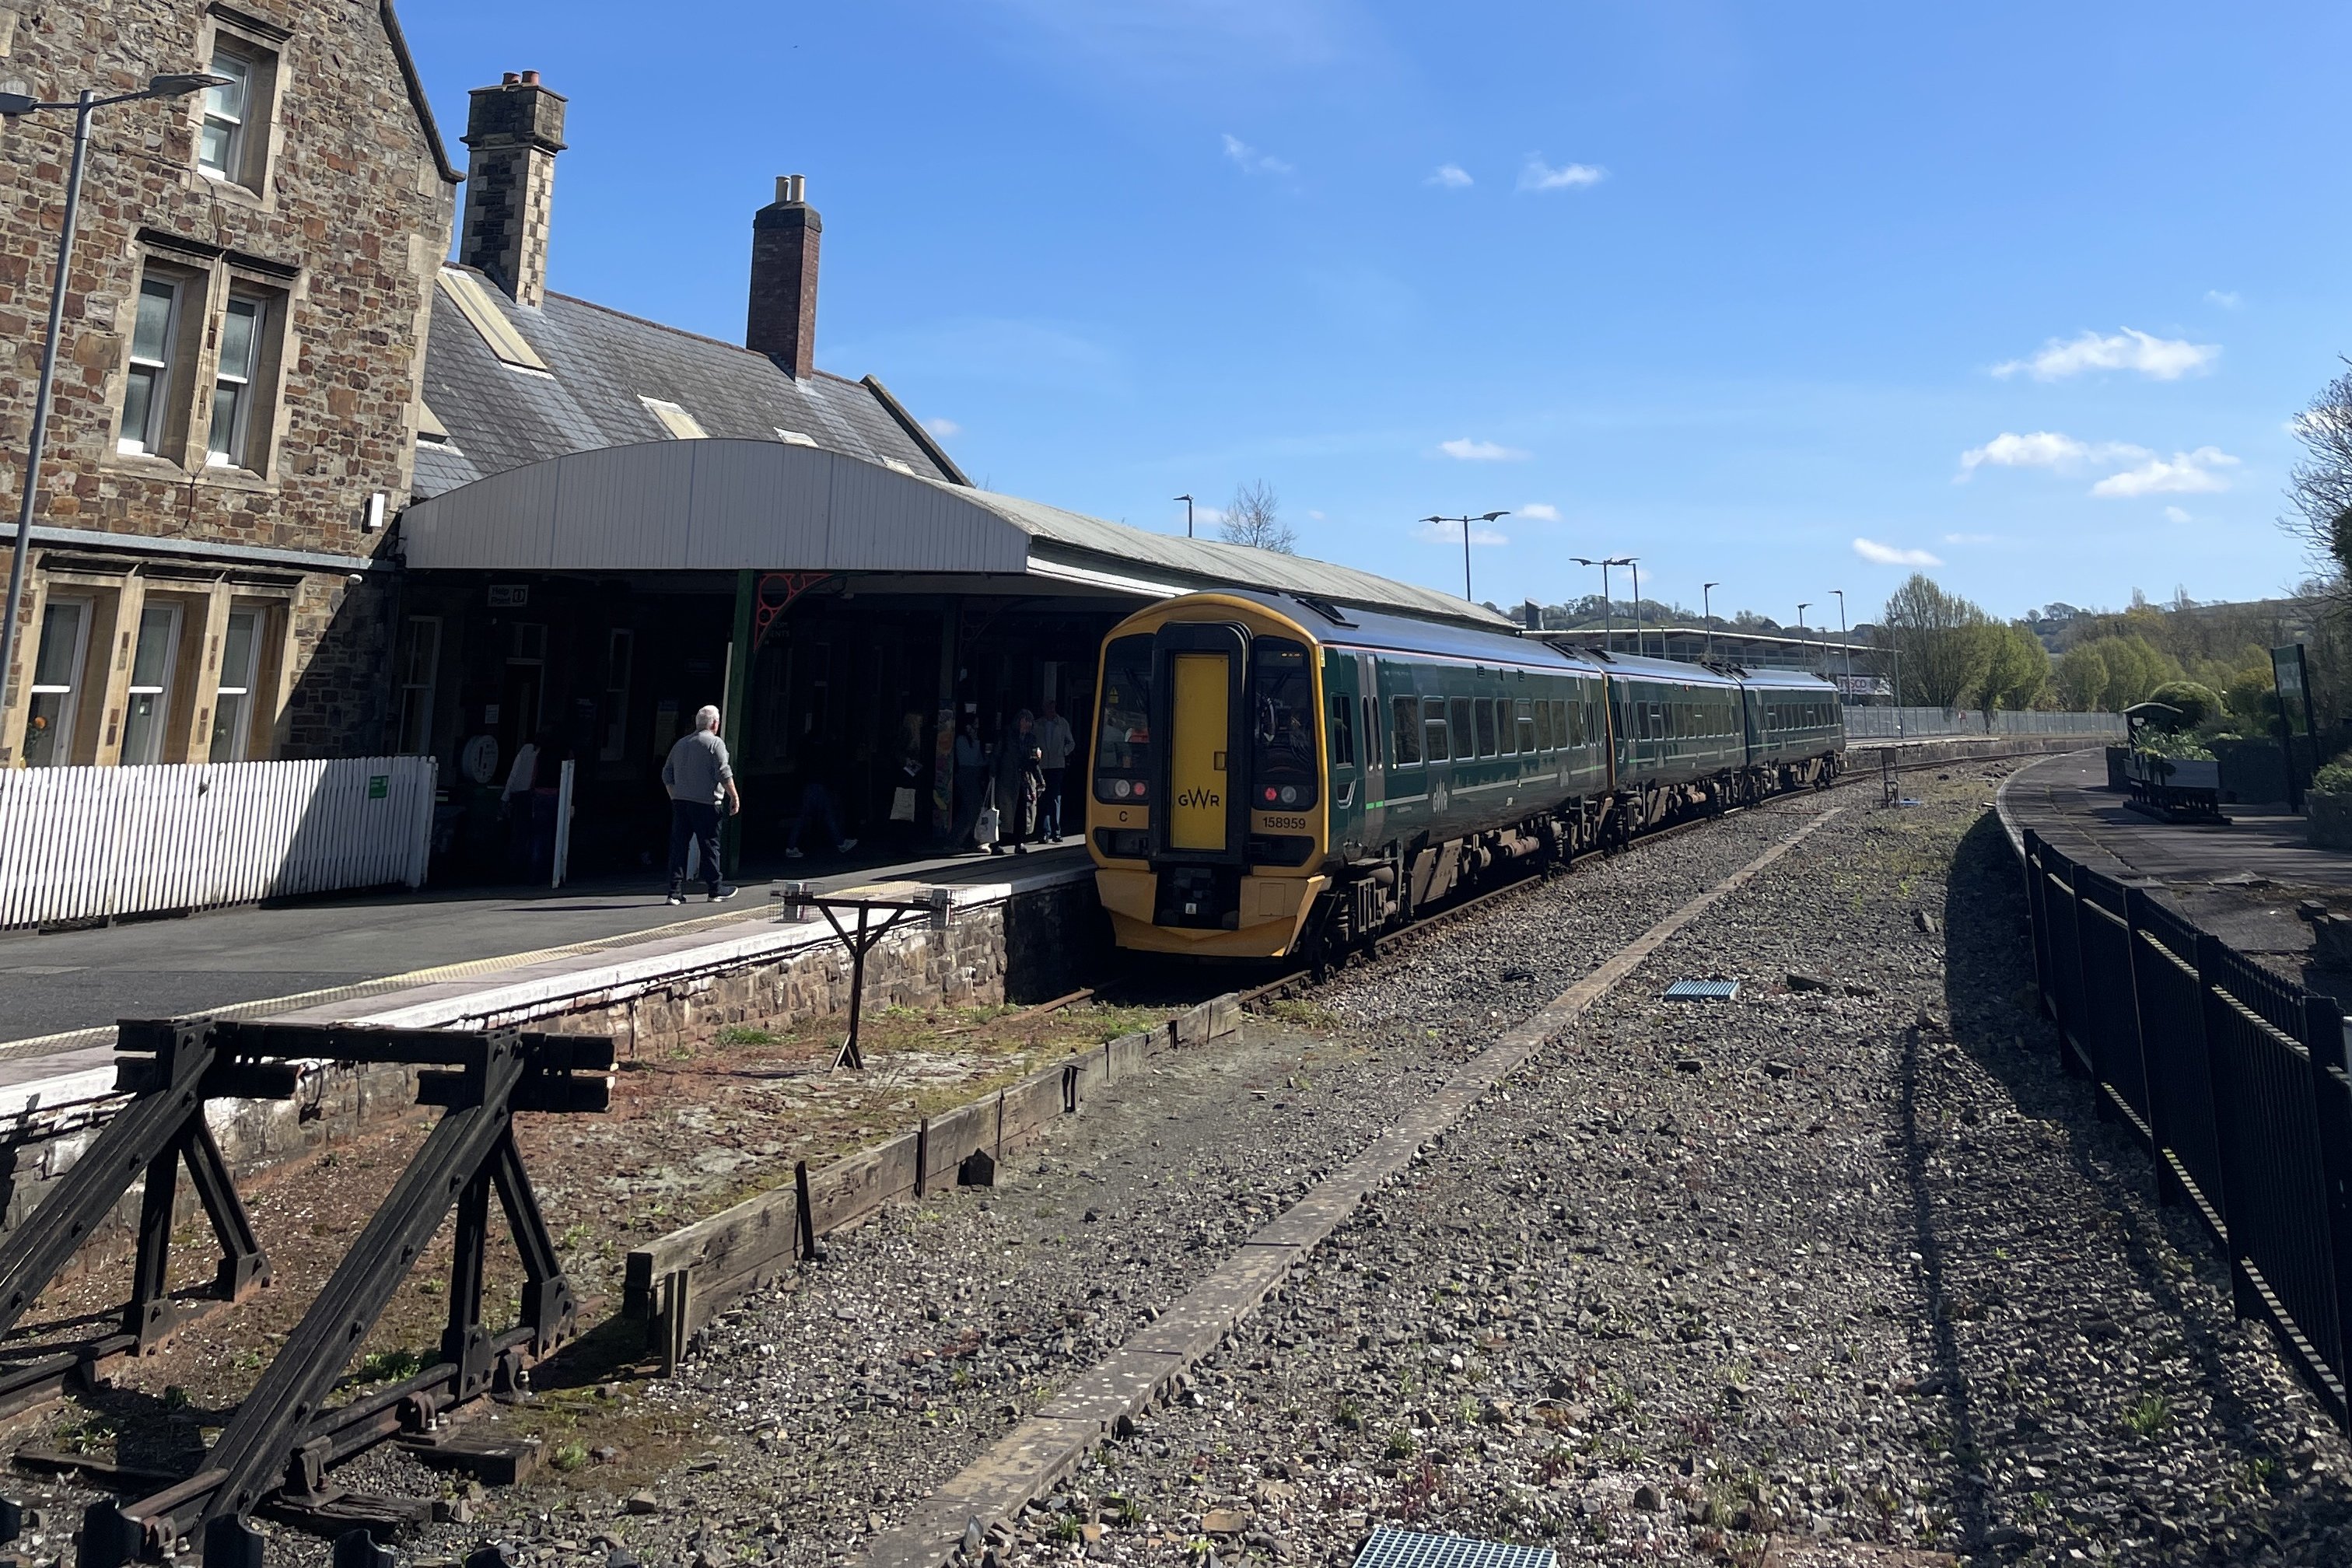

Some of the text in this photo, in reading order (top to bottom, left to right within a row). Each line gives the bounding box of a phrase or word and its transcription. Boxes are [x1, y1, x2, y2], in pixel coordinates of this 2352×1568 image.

[492, 586, 509, 597] Help
[1178, 786, 1220, 810] GWR
[1432, 778, 1448, 814] GWR
[1119, 811, 1128, 822] C
[1263, 817, 1306, 830] 158959
